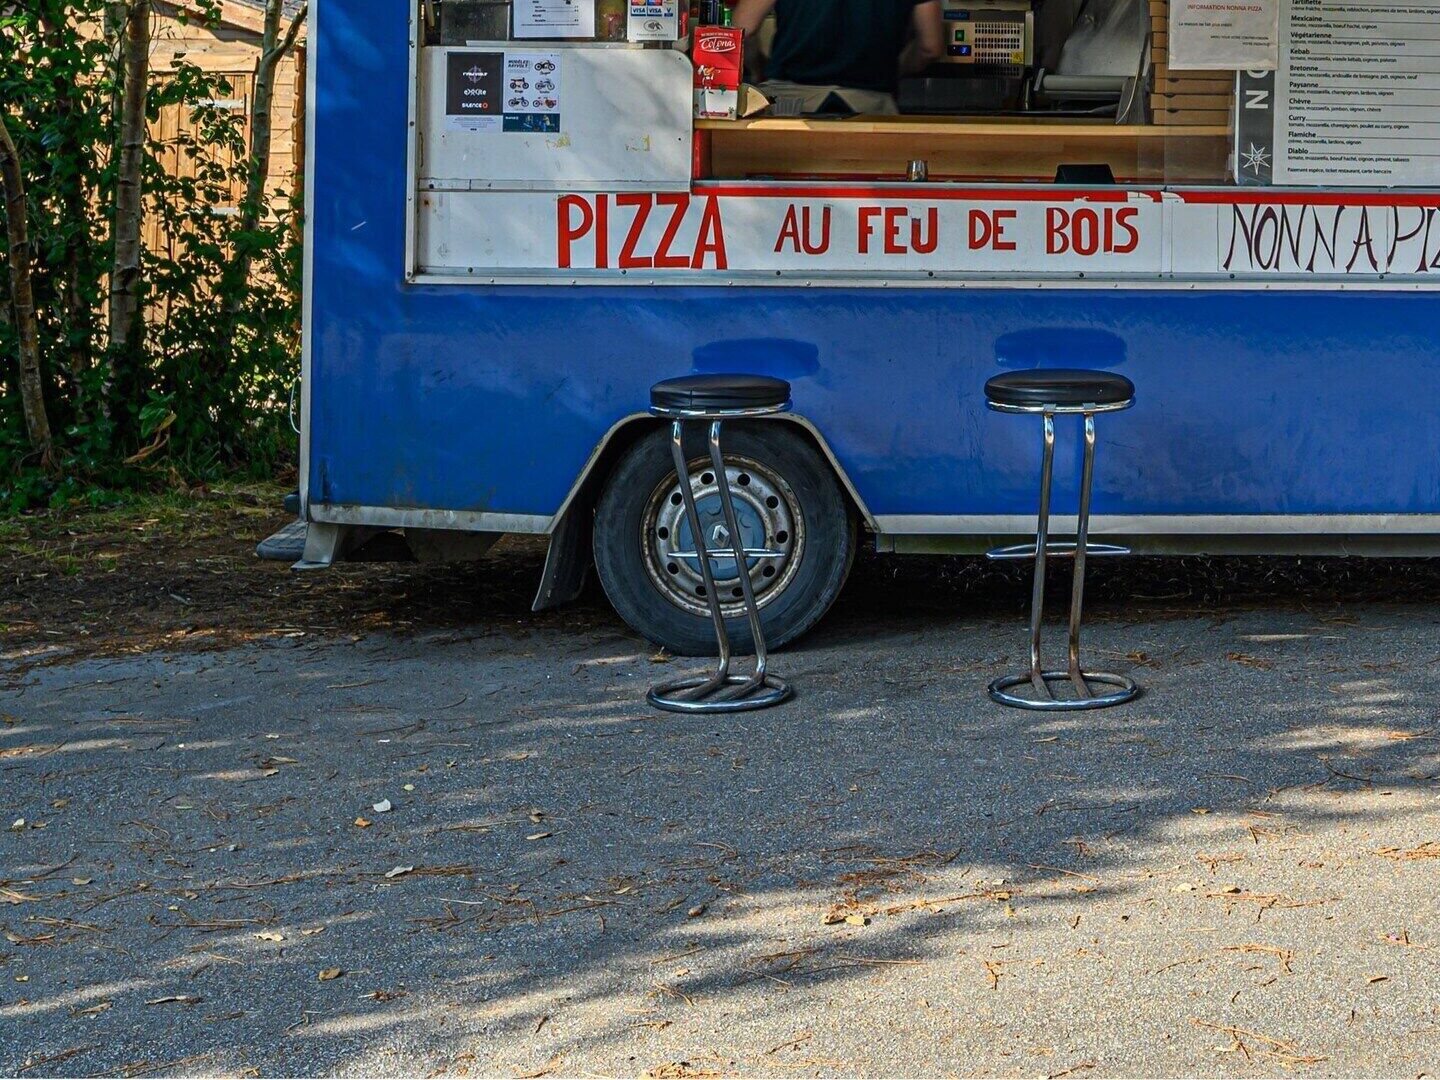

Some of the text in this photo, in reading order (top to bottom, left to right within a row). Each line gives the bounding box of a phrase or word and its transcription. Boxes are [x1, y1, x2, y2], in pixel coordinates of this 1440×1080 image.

[1290, 31, 1332, 40] Végétarienne
[1289, 81, 1319, 89] Paysanne
[557, 193, 1139, 270] PIZZA AU FEU DE BOIS
[1223, 204, 1379, 273] NONNA
